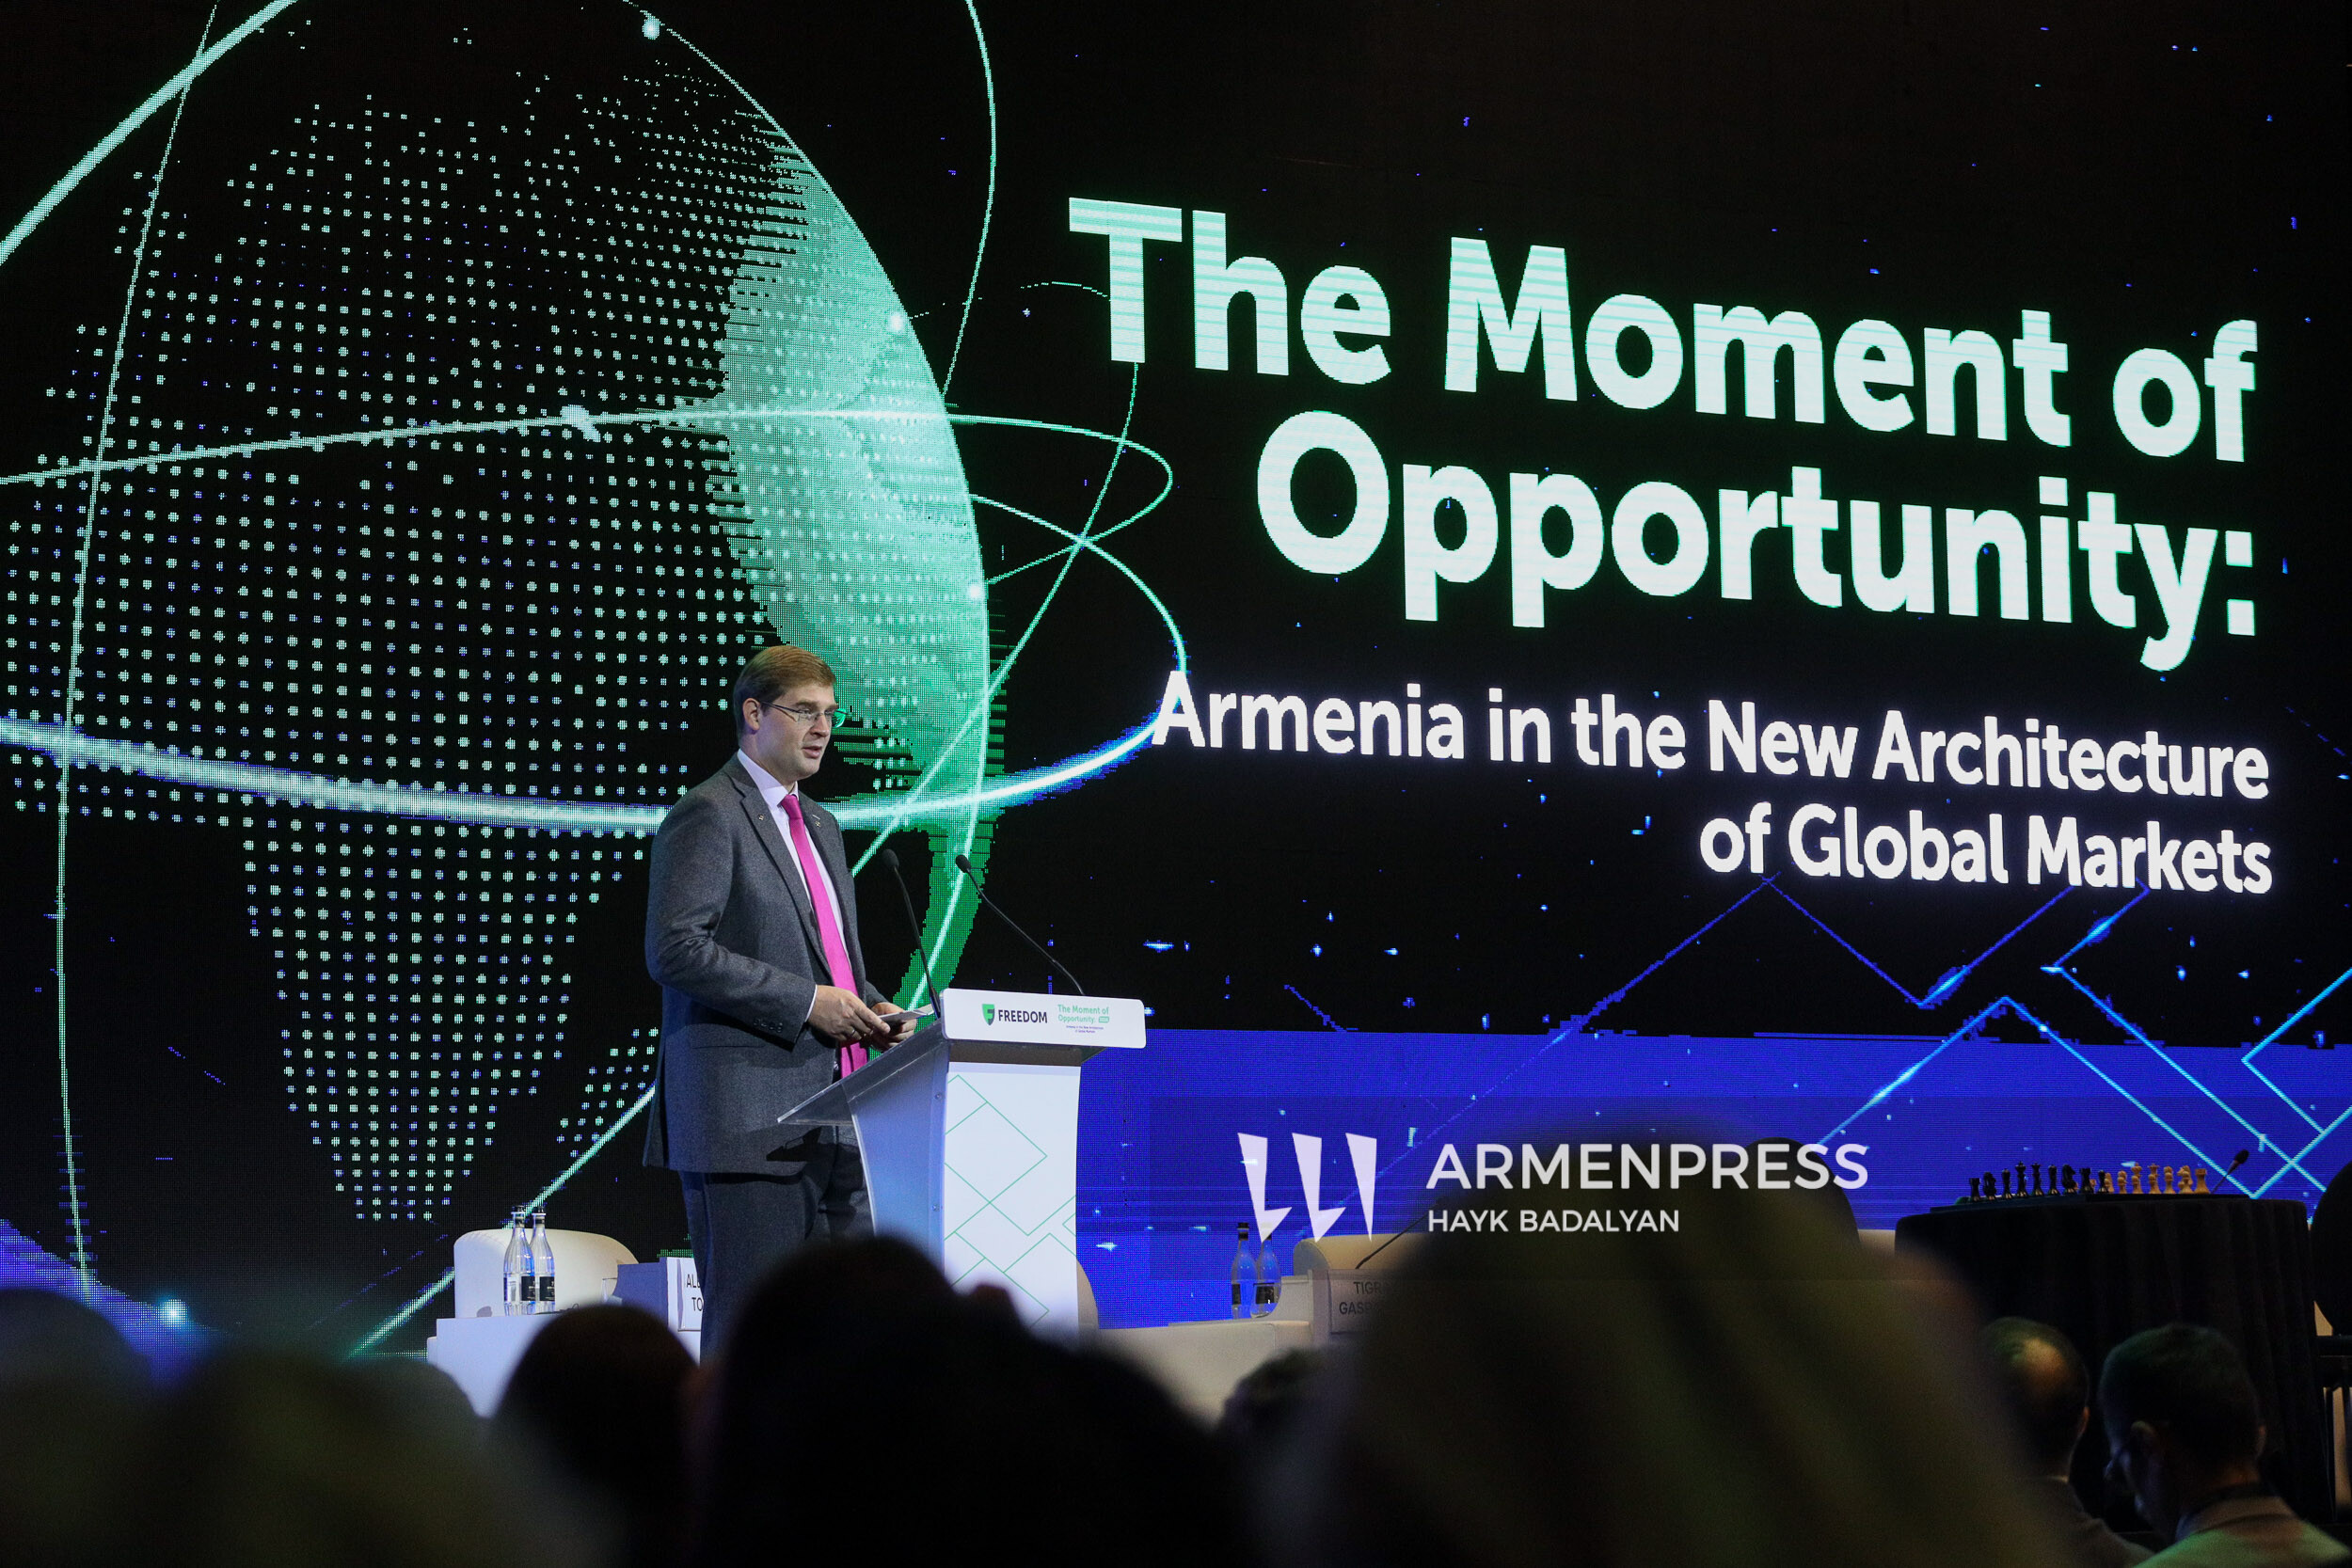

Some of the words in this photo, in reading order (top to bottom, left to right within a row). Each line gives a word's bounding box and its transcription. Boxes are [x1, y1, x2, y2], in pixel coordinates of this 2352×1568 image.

[1069, 198, 1391, 385] The
[1445, 237, 2070, 446] Moment
[2113, 320, 2257, 462] of
[1258, 410, 2254, 671] Opportunity:
[1152, 671, 1464, 759] Armenia
[1489, 688, 1550, 763] in
[1571, 694, 1686, 769] the
[1708, 700, 1858, 778] New
[1872, 710, 2268, 799] Architecture
[1700, 801, 1772, 873] of
[1788, 803, 2009, 883] Global
[2027, 816, 2272, 894] Markets
[998, 1009, 1048, 1023] FREEDOM
[1057, 1005, 1071, 1013] The
[1073, 1006, 1100, 1014] Moment
[1102, 1006, 1109, 1015] of
[691, 1297, 704, 1312] TO
[1353, 1281, 1383, 1295] TIGR
